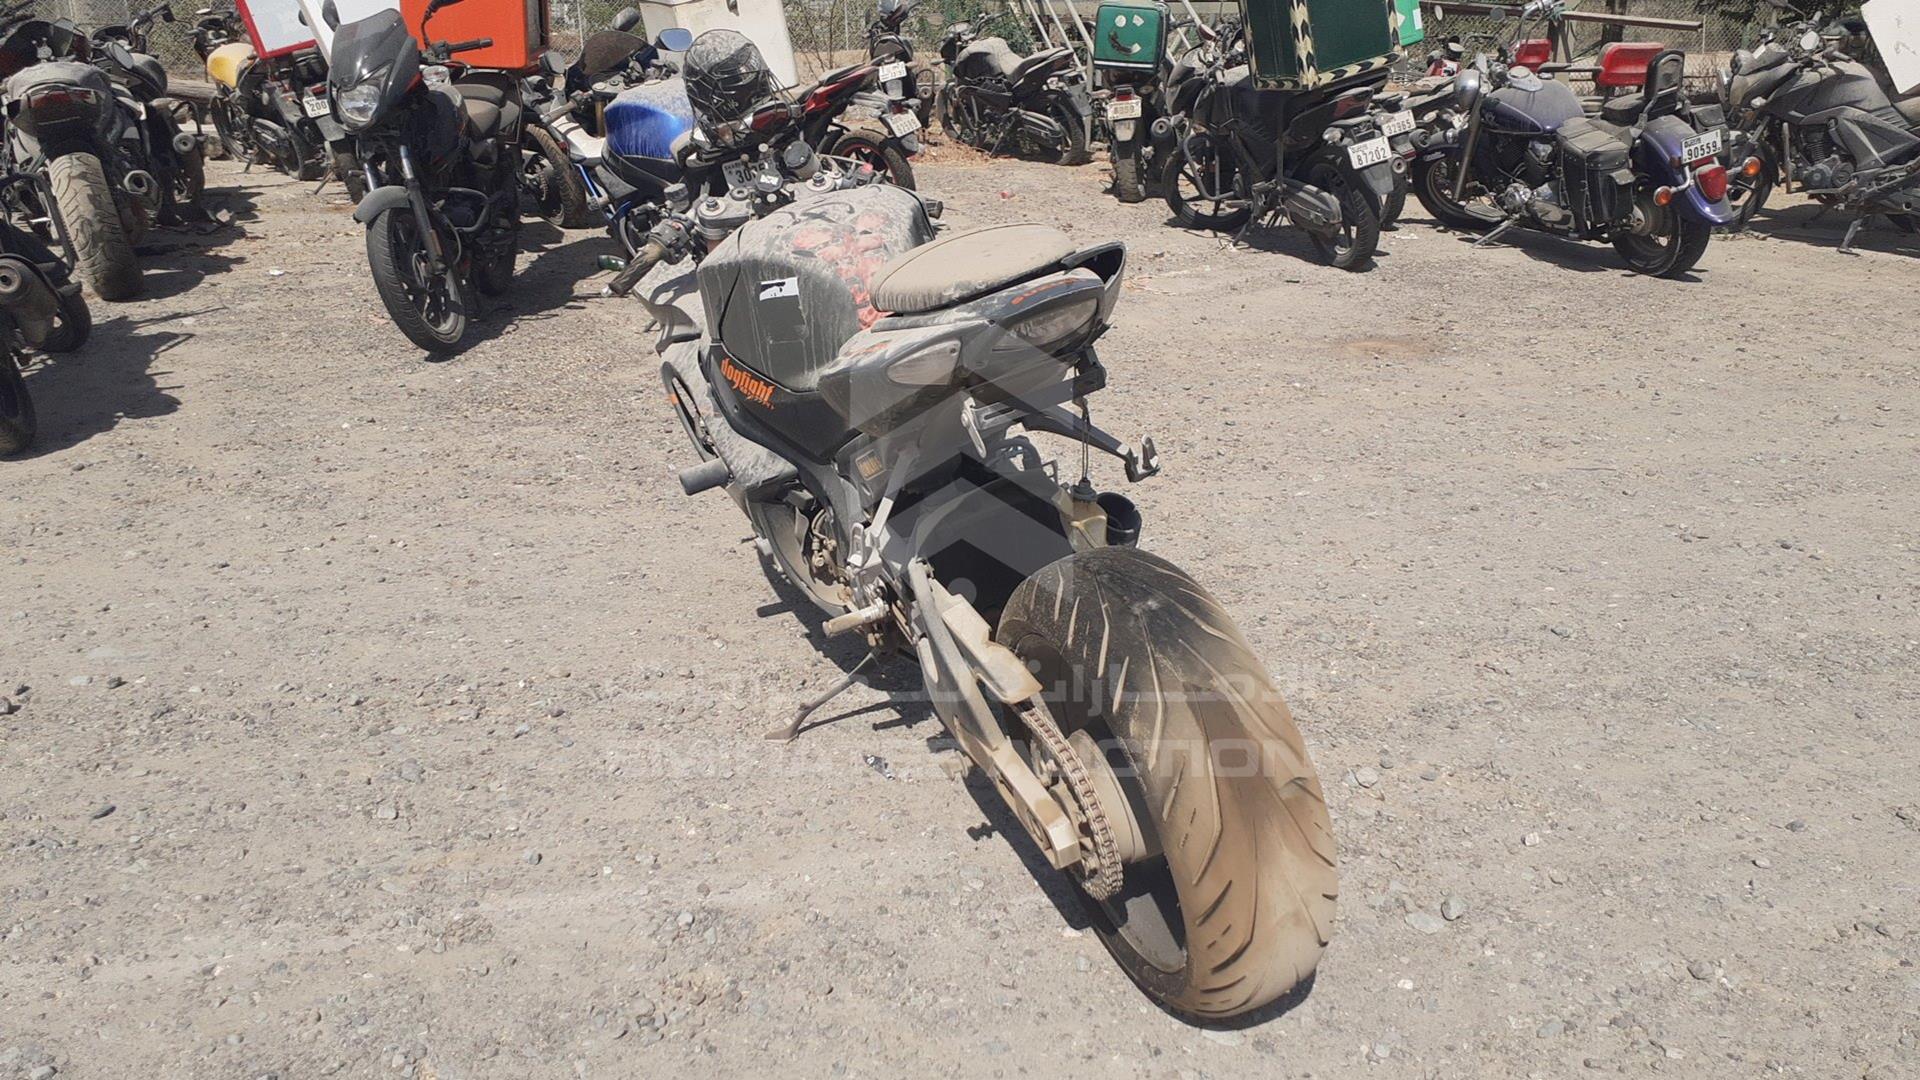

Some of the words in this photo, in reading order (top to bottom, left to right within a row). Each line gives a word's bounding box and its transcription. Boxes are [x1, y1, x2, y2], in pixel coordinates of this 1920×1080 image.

[1357, 147, 1388, 166] 87202
[1687, 140, 1718, 161] 90559
[720, 357, 777, 403] dogfight
